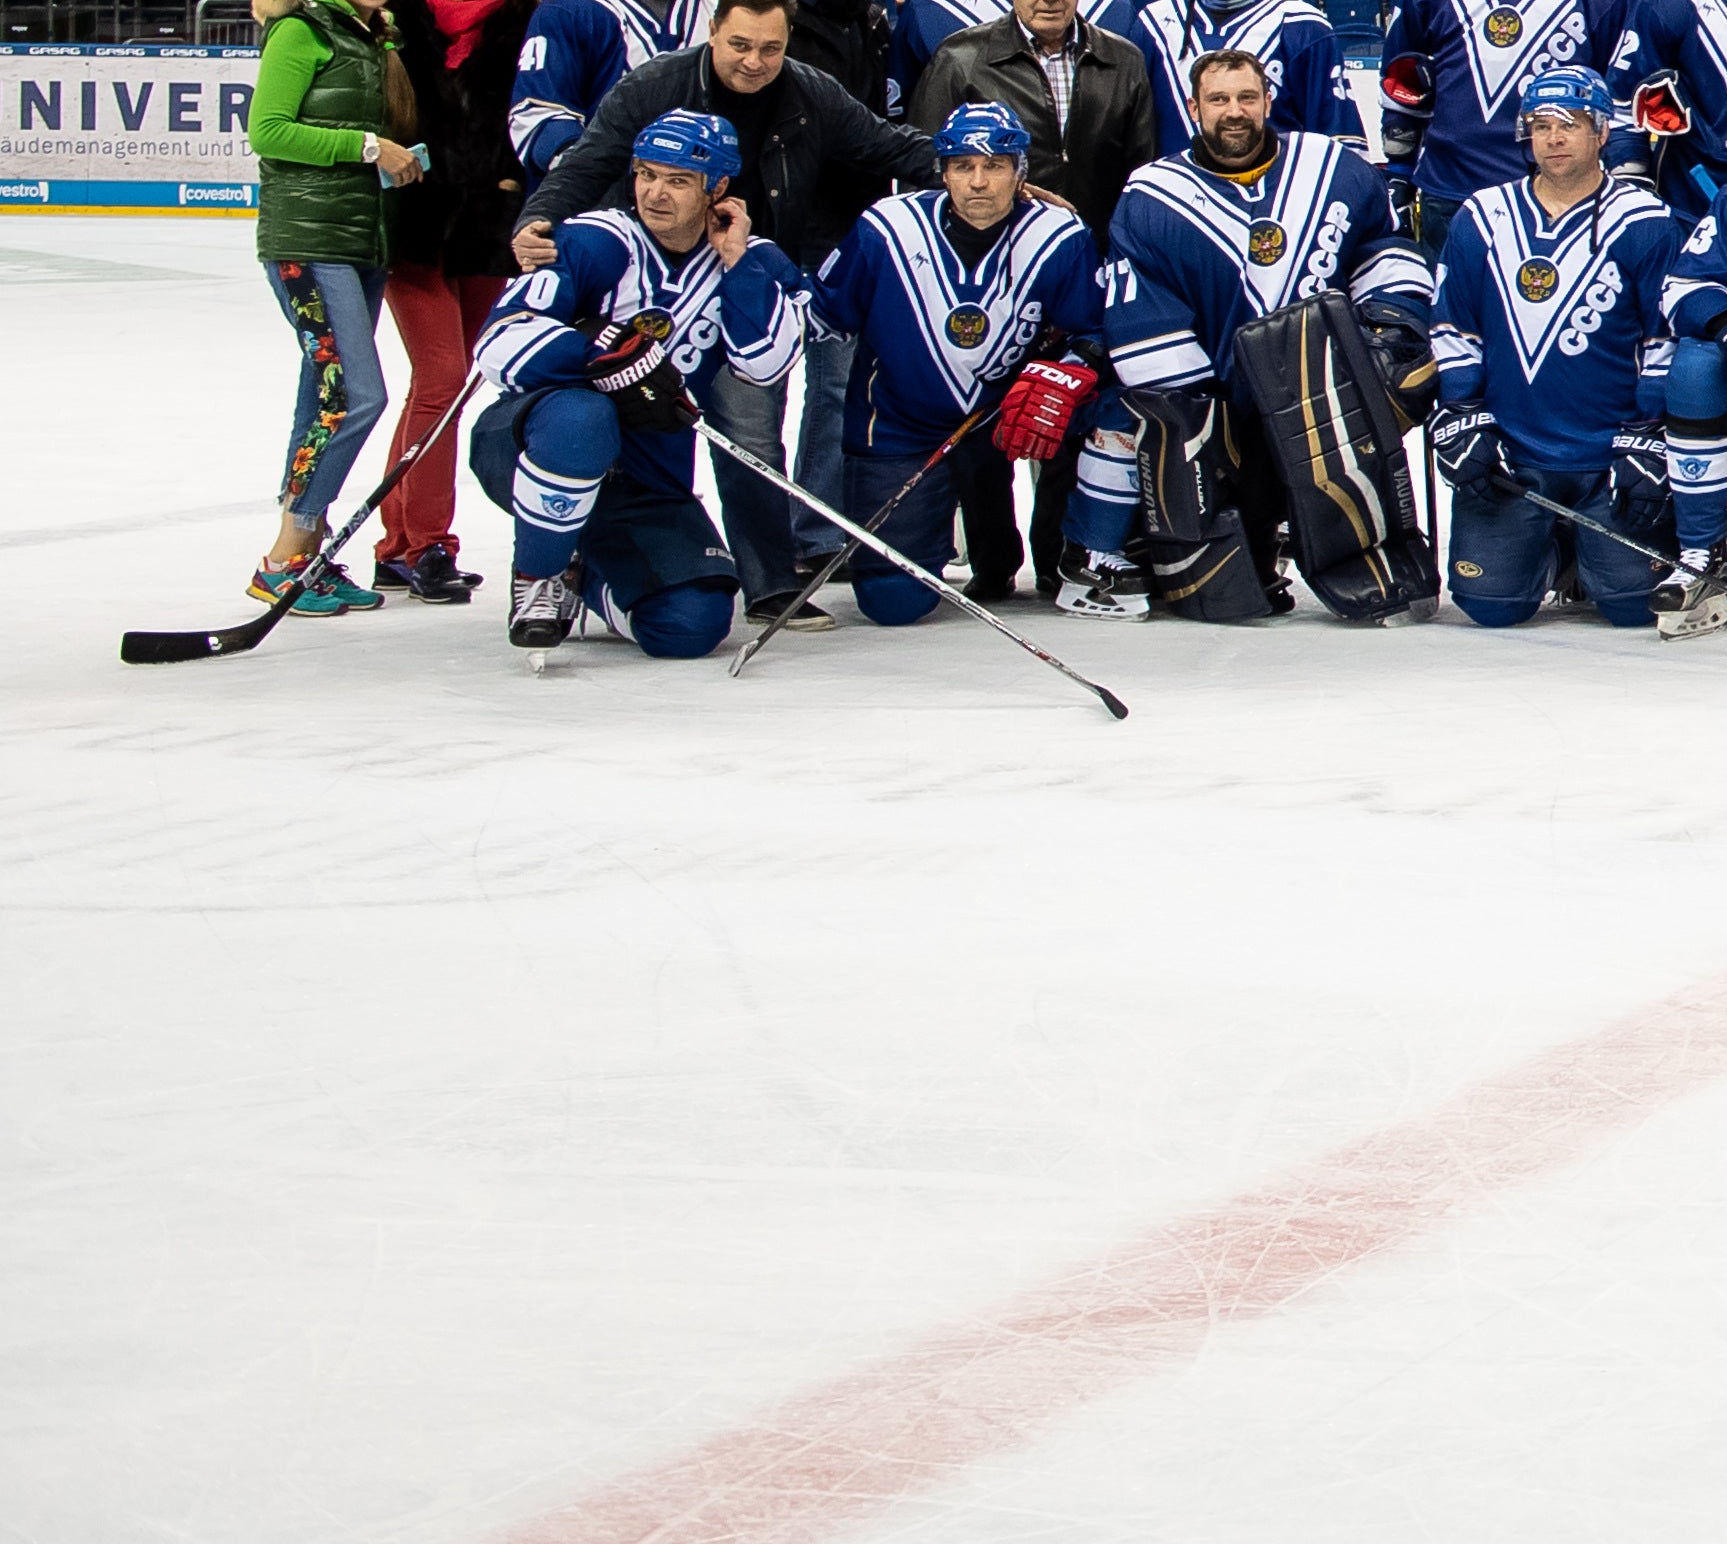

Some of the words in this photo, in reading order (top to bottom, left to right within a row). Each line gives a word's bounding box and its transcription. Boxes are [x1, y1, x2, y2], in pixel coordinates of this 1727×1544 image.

[29, 46, 81, 56] GASAG
[96, 47, 146, 57] GASAG
[160, 48, 208, 58] GASAG
[20, 79, 256, 133] NIVER
[0, 136, 191, 158] äudemanagement
[198, 139, 233, 156] und
[185, 188, 246, 202] covestro
[1558, 260, 1623, 356] СССР
[1022, 361, 1083, 391] STON
